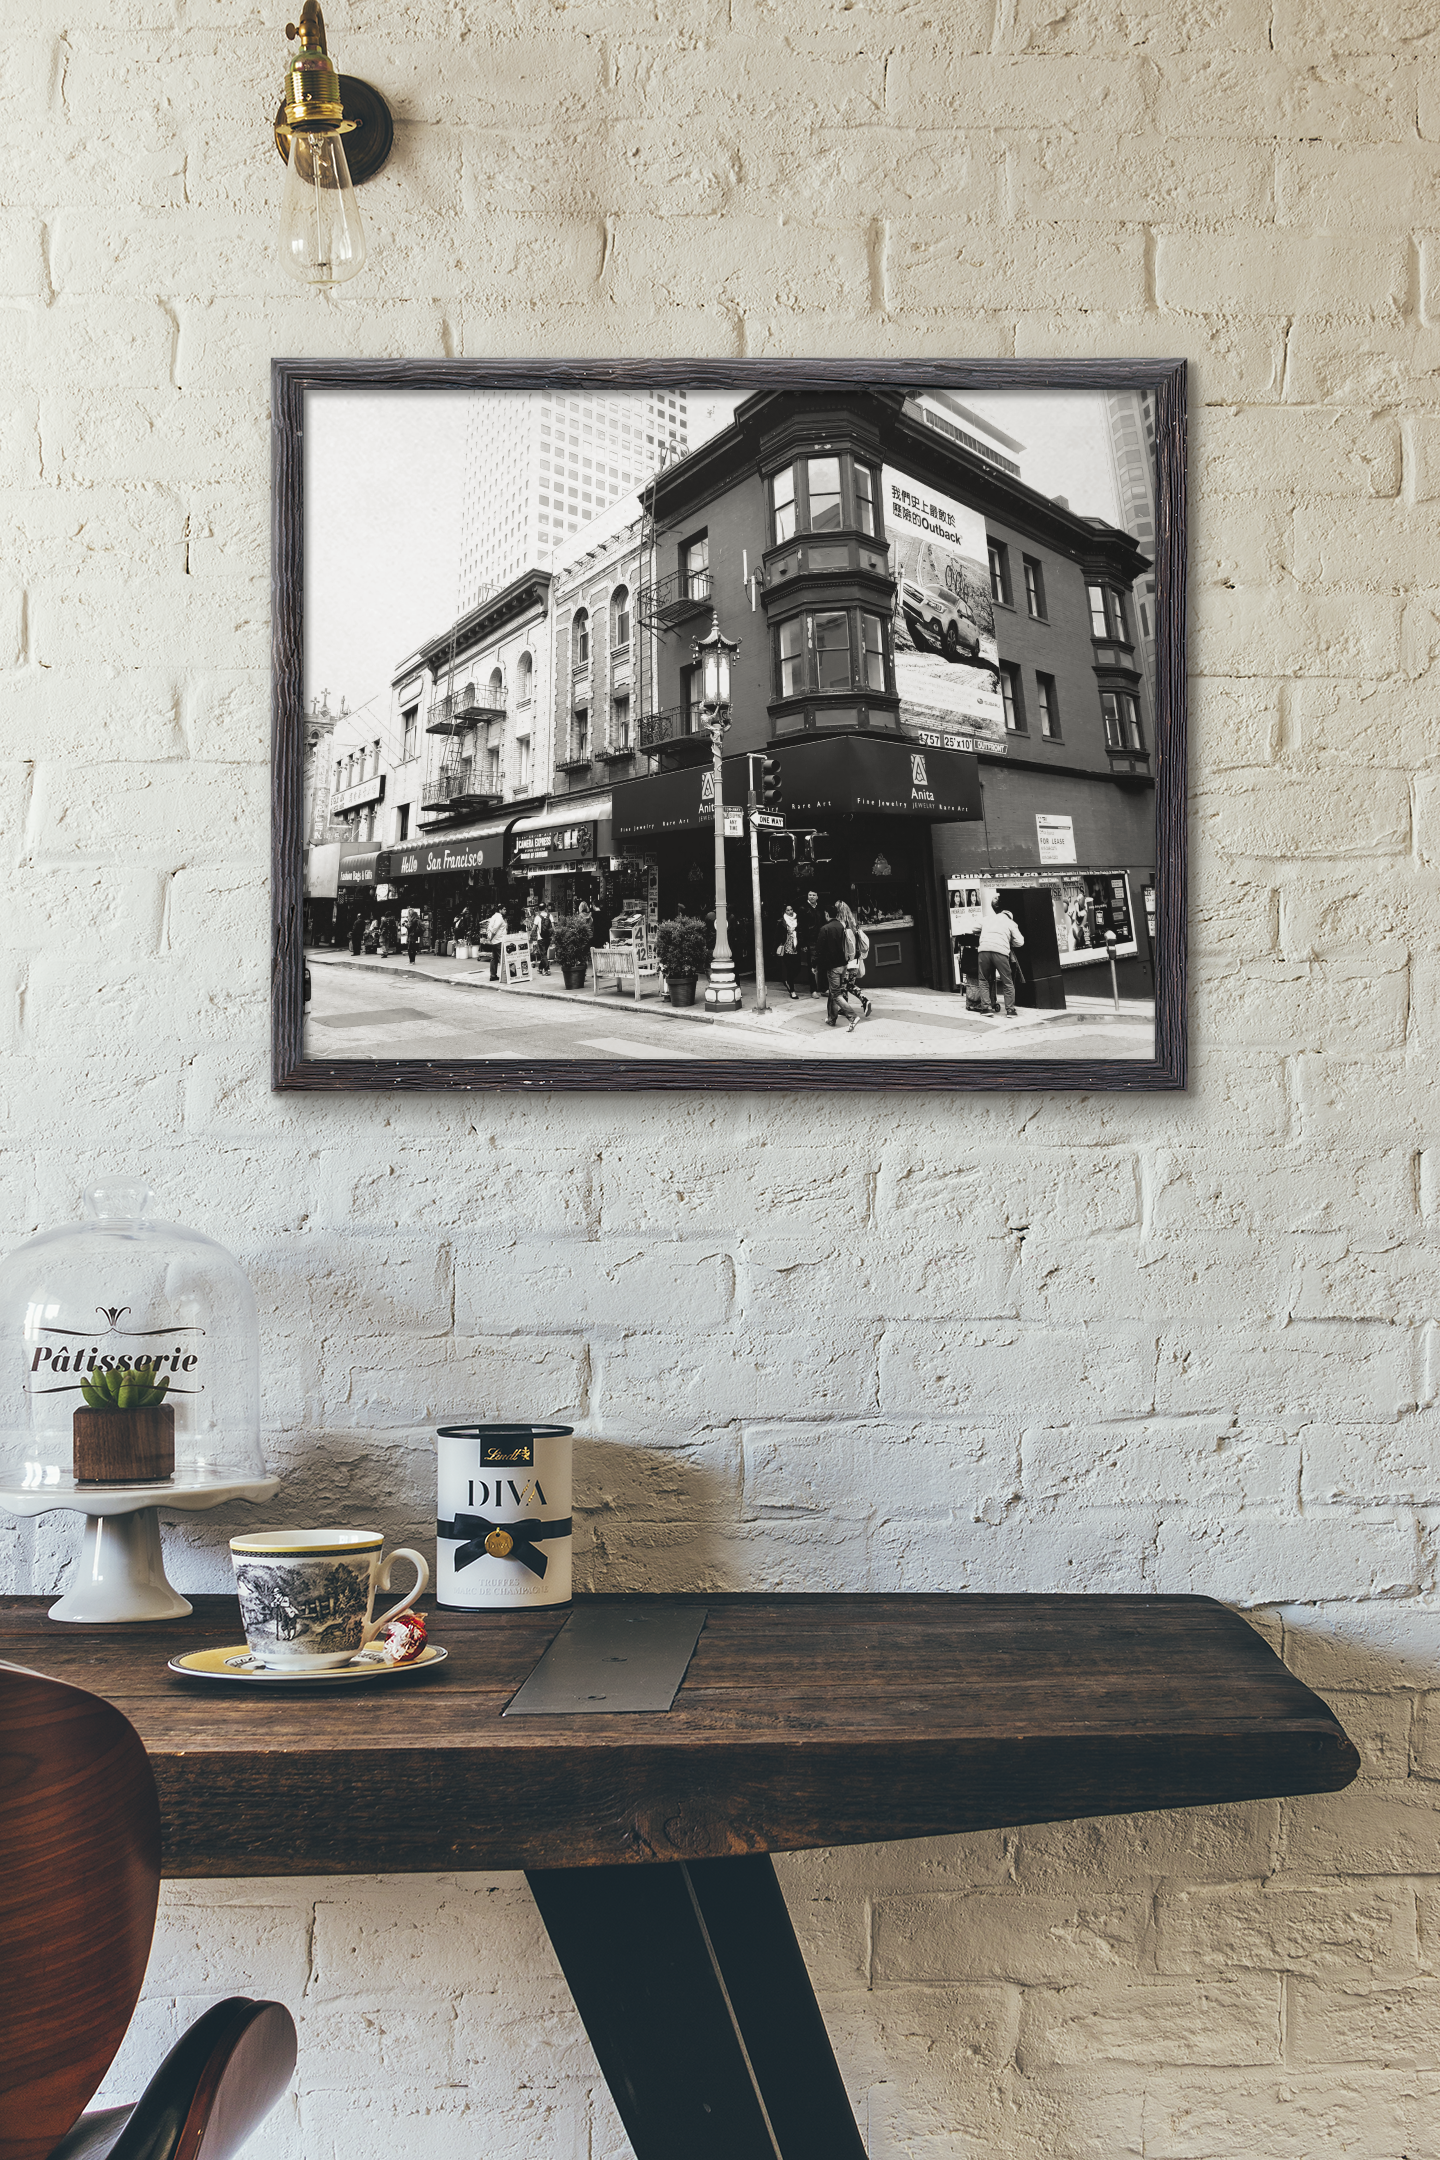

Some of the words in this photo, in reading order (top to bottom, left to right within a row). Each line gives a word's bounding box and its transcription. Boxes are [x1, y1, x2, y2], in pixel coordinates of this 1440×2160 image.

[977, 741, 1005, 753] OUTFRONT
[911, 787, 935, 801] Anita
[698, 803, 715, 814] Anit
[857, 797, 875, 806] Fine
[878, 799, 907, 809] Jewelry
[759, 815, 770, 824] ONE
[771, 817, 783, 826] WAY
[518, 838, 534, 849] CAMERA
[534, 836, 552, 847] EXPRESS
[1040, 837, 1050, 845] FOR
[401, 855, 418, 874] Hello
[426, 852, 442, 871] San
[443, 847, 484, 869] Francisco
[635, 926, 644, 942] 4
[637, 947, 647, 962] 12
[31, 1346, 198, 1373] Pâtisserie
[484, 1447, 522, 1461] Lindt
[468, 1479, 547, 1507] DIVA
[488, 1541, 510, 1549] DIVA
[479, 1578, 521, 1587] TRUFFES
[453, 1587, 477, 1595] MARC
[479, 1587, 491, 1596] DE
[493, 1586, 549, 1596] CHAMPAGNE
